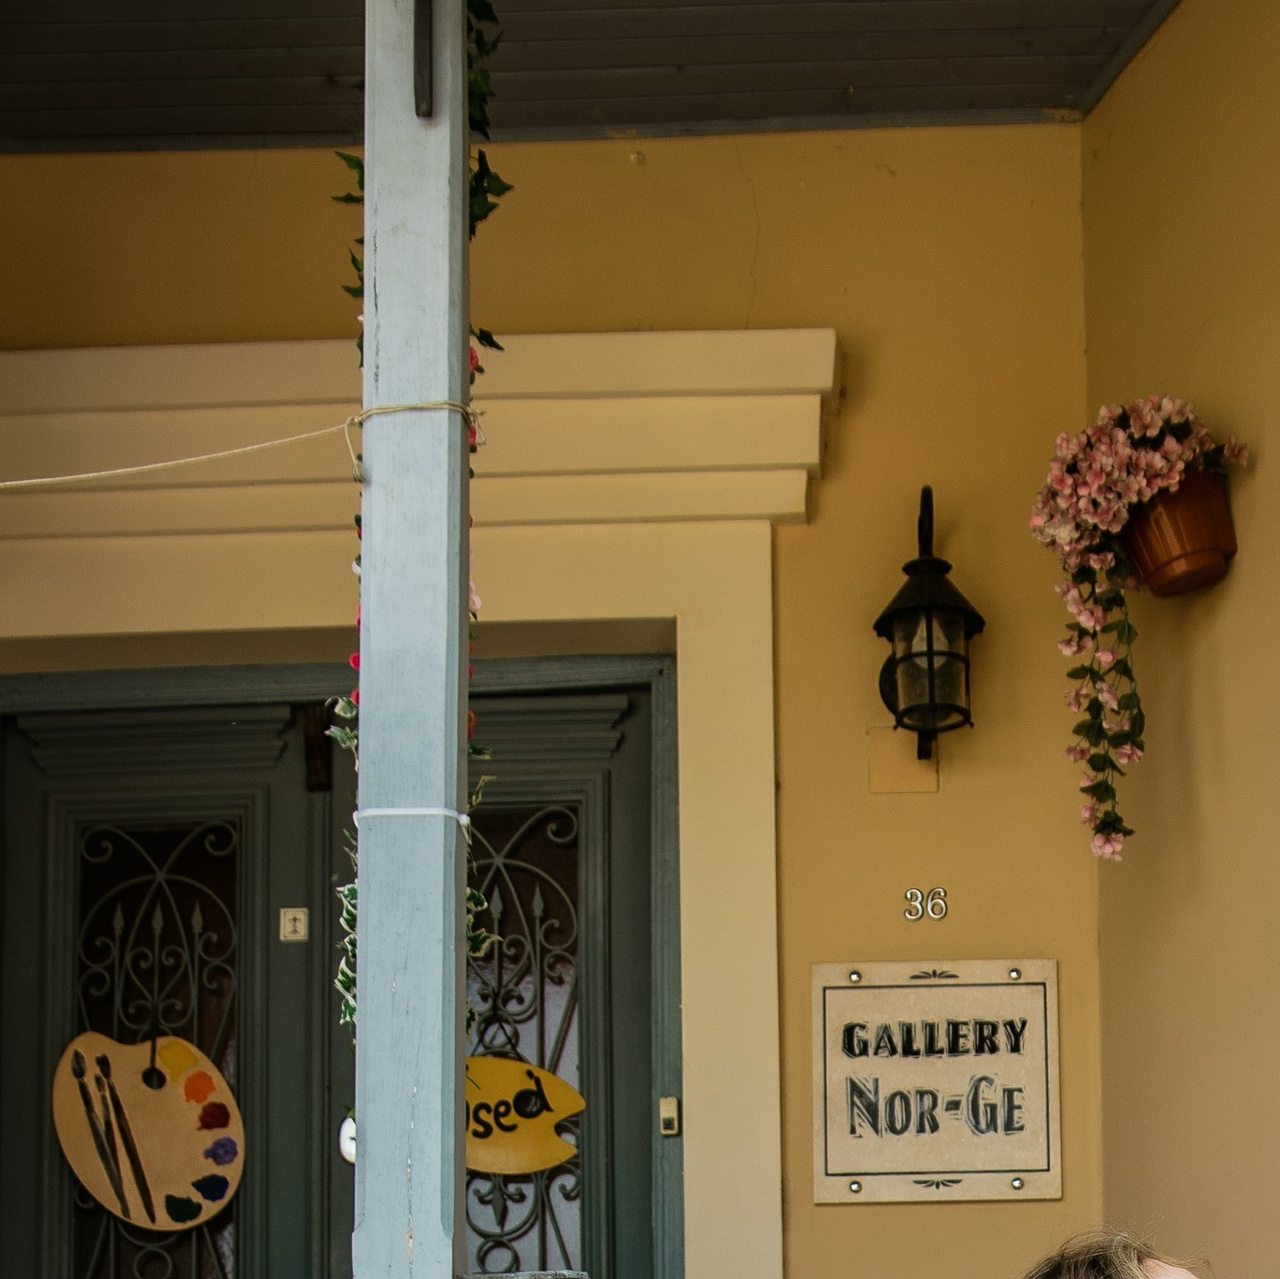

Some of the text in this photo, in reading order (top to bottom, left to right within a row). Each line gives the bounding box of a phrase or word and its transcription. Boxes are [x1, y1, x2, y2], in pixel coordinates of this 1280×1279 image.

[903, 886, 949, 922] 36
[841, 1017, 1029, 1059] GALLERY
[466, 1068, 554, 1139] sed
